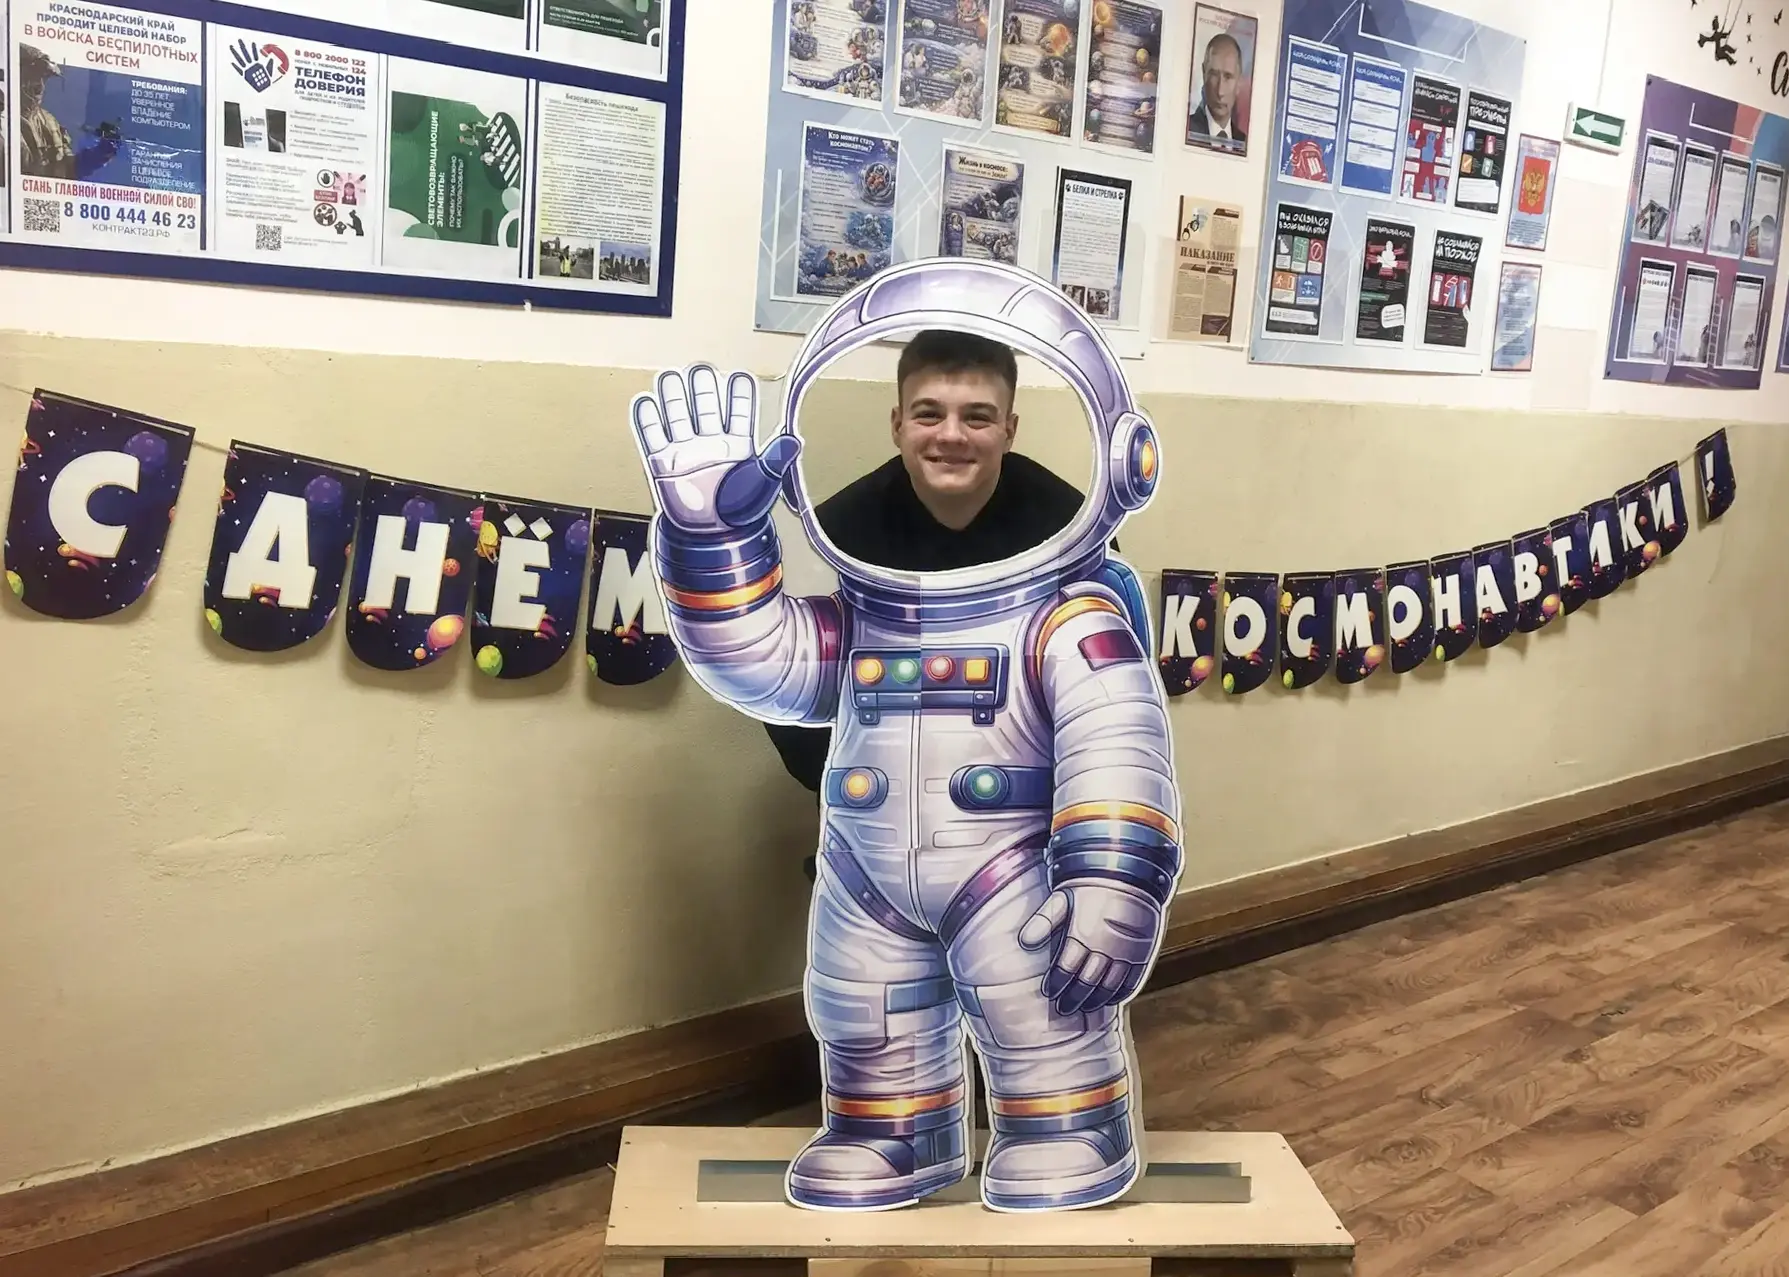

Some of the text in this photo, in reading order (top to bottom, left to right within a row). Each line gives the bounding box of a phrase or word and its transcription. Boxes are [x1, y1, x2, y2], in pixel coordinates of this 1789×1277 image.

[36, 12, 187, 44] ПРОВОДИТ ЦЕЛЕВОЙ НАБОР
[50, 4, 175, 32] КРАСНОДАРСКИЙ КРАЙ
[24, 24, 199, 64] В ВОЙСКА БЕСПИЛОТНЫХ
[86, 50, 140, 70] СИСТЕМ
[303, 50, 322, 60] 800
[325, 53, 348, 64] 2000
[352, 58, 366, 68] 122
[352, 67, 366, 76] 124
[130, 80, 188, 95] ТРЕБОВАНИЯ:
[294, 66, 366, 86] ТЕЛЕФОН
[294, 78, 366, 97] ДОВЕРИЯ
[131, 116, 191, 130] КОМПЬЮТЕРОМ
[428, 110, 439, 226] СВЕТОВОЗВРАЩАЮЩИЕ
[450, 155, 458, 184] ВАЖНО
[22, 178, 196, 210] СТАНЬ ГЛАВНОЙ ВОЕННОЙ СИЛОЙ СВО!
[436, 171, 446, 228] ЭЛЕМЕНТЫ:
[64, 201, 196, 230] 8 800 444 46 23
[1180, 246, 1236, 262] НАКАЗАНИЕ
[47, 450, 140, 559] С
[222, 490, 668, 636] ДНЁМ
[1704, 450, 1716, 497] !
